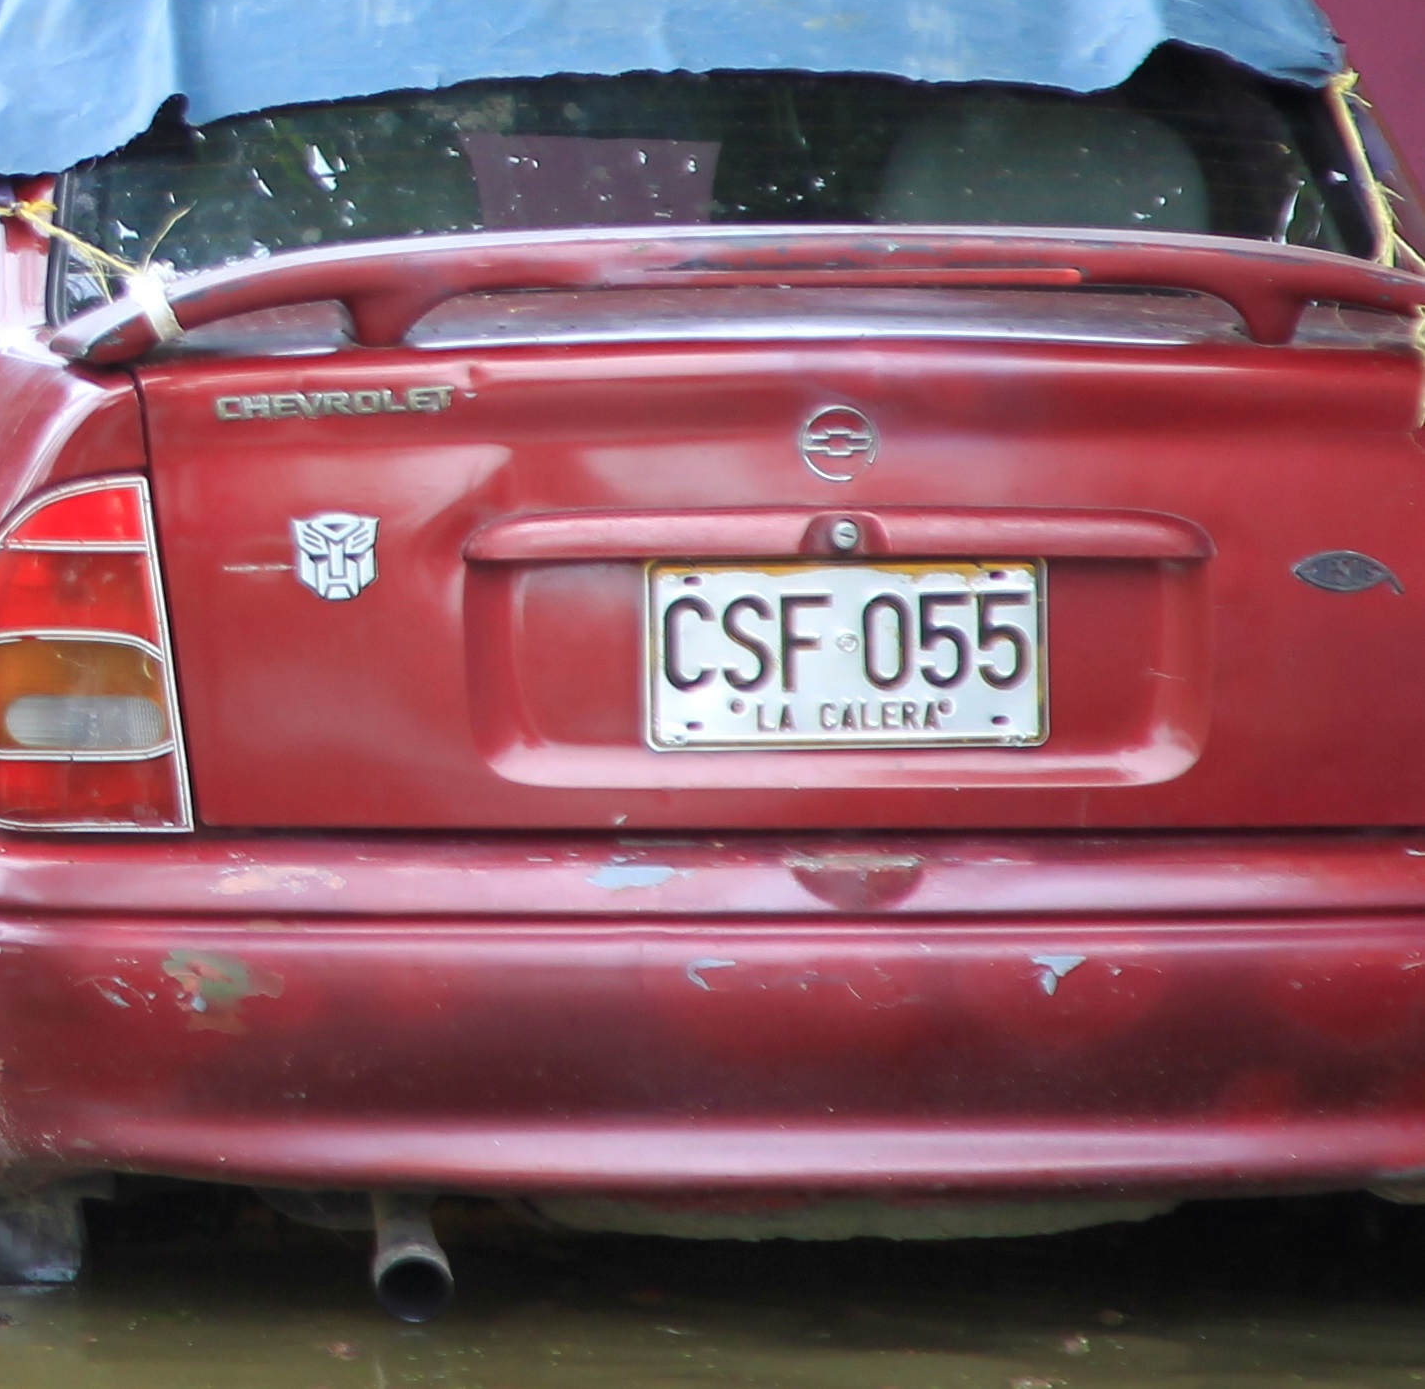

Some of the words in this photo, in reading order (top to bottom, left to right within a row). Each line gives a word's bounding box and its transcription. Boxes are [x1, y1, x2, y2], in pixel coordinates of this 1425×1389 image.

[216, 384, 457, 421] CHEVROLET
[664, 591, 834, 692] CSF
[863, 591, 1033, 692] 055
[756, 700, 798, 732] LA
[820, 698, 943, 731] CALERA
